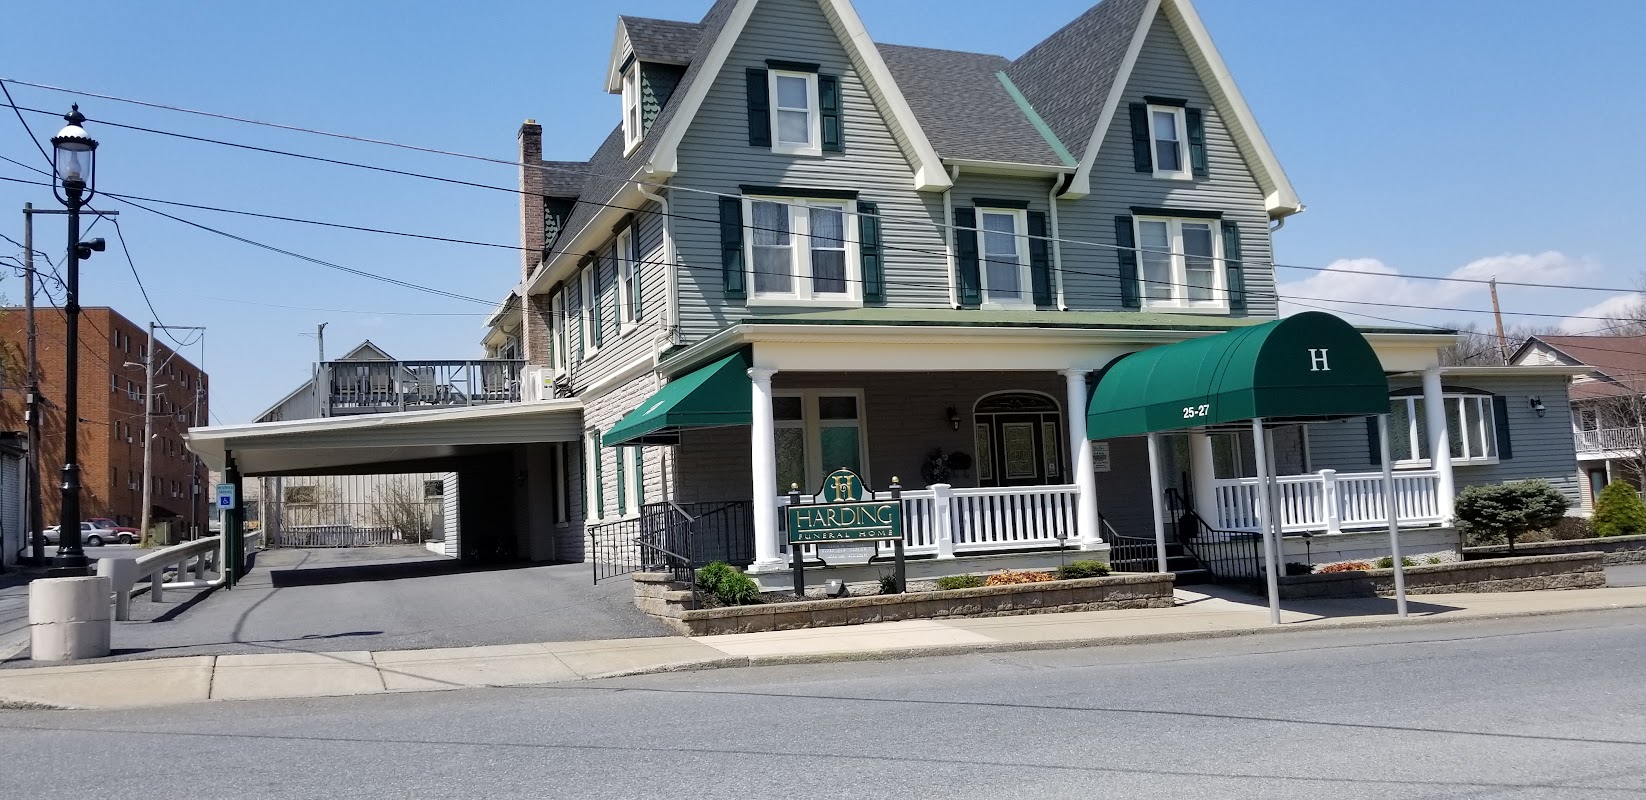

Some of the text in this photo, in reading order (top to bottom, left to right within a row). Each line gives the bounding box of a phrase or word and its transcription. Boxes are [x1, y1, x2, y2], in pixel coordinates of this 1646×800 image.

[1307, 348, 1331, 372] H
[1182, 403, 1210, 419] 25-27
[830, 474, 856, 502] H
[796, 505, 893, 528] HARDING
[798, 529, 893, 540] FUNERAL HOME
